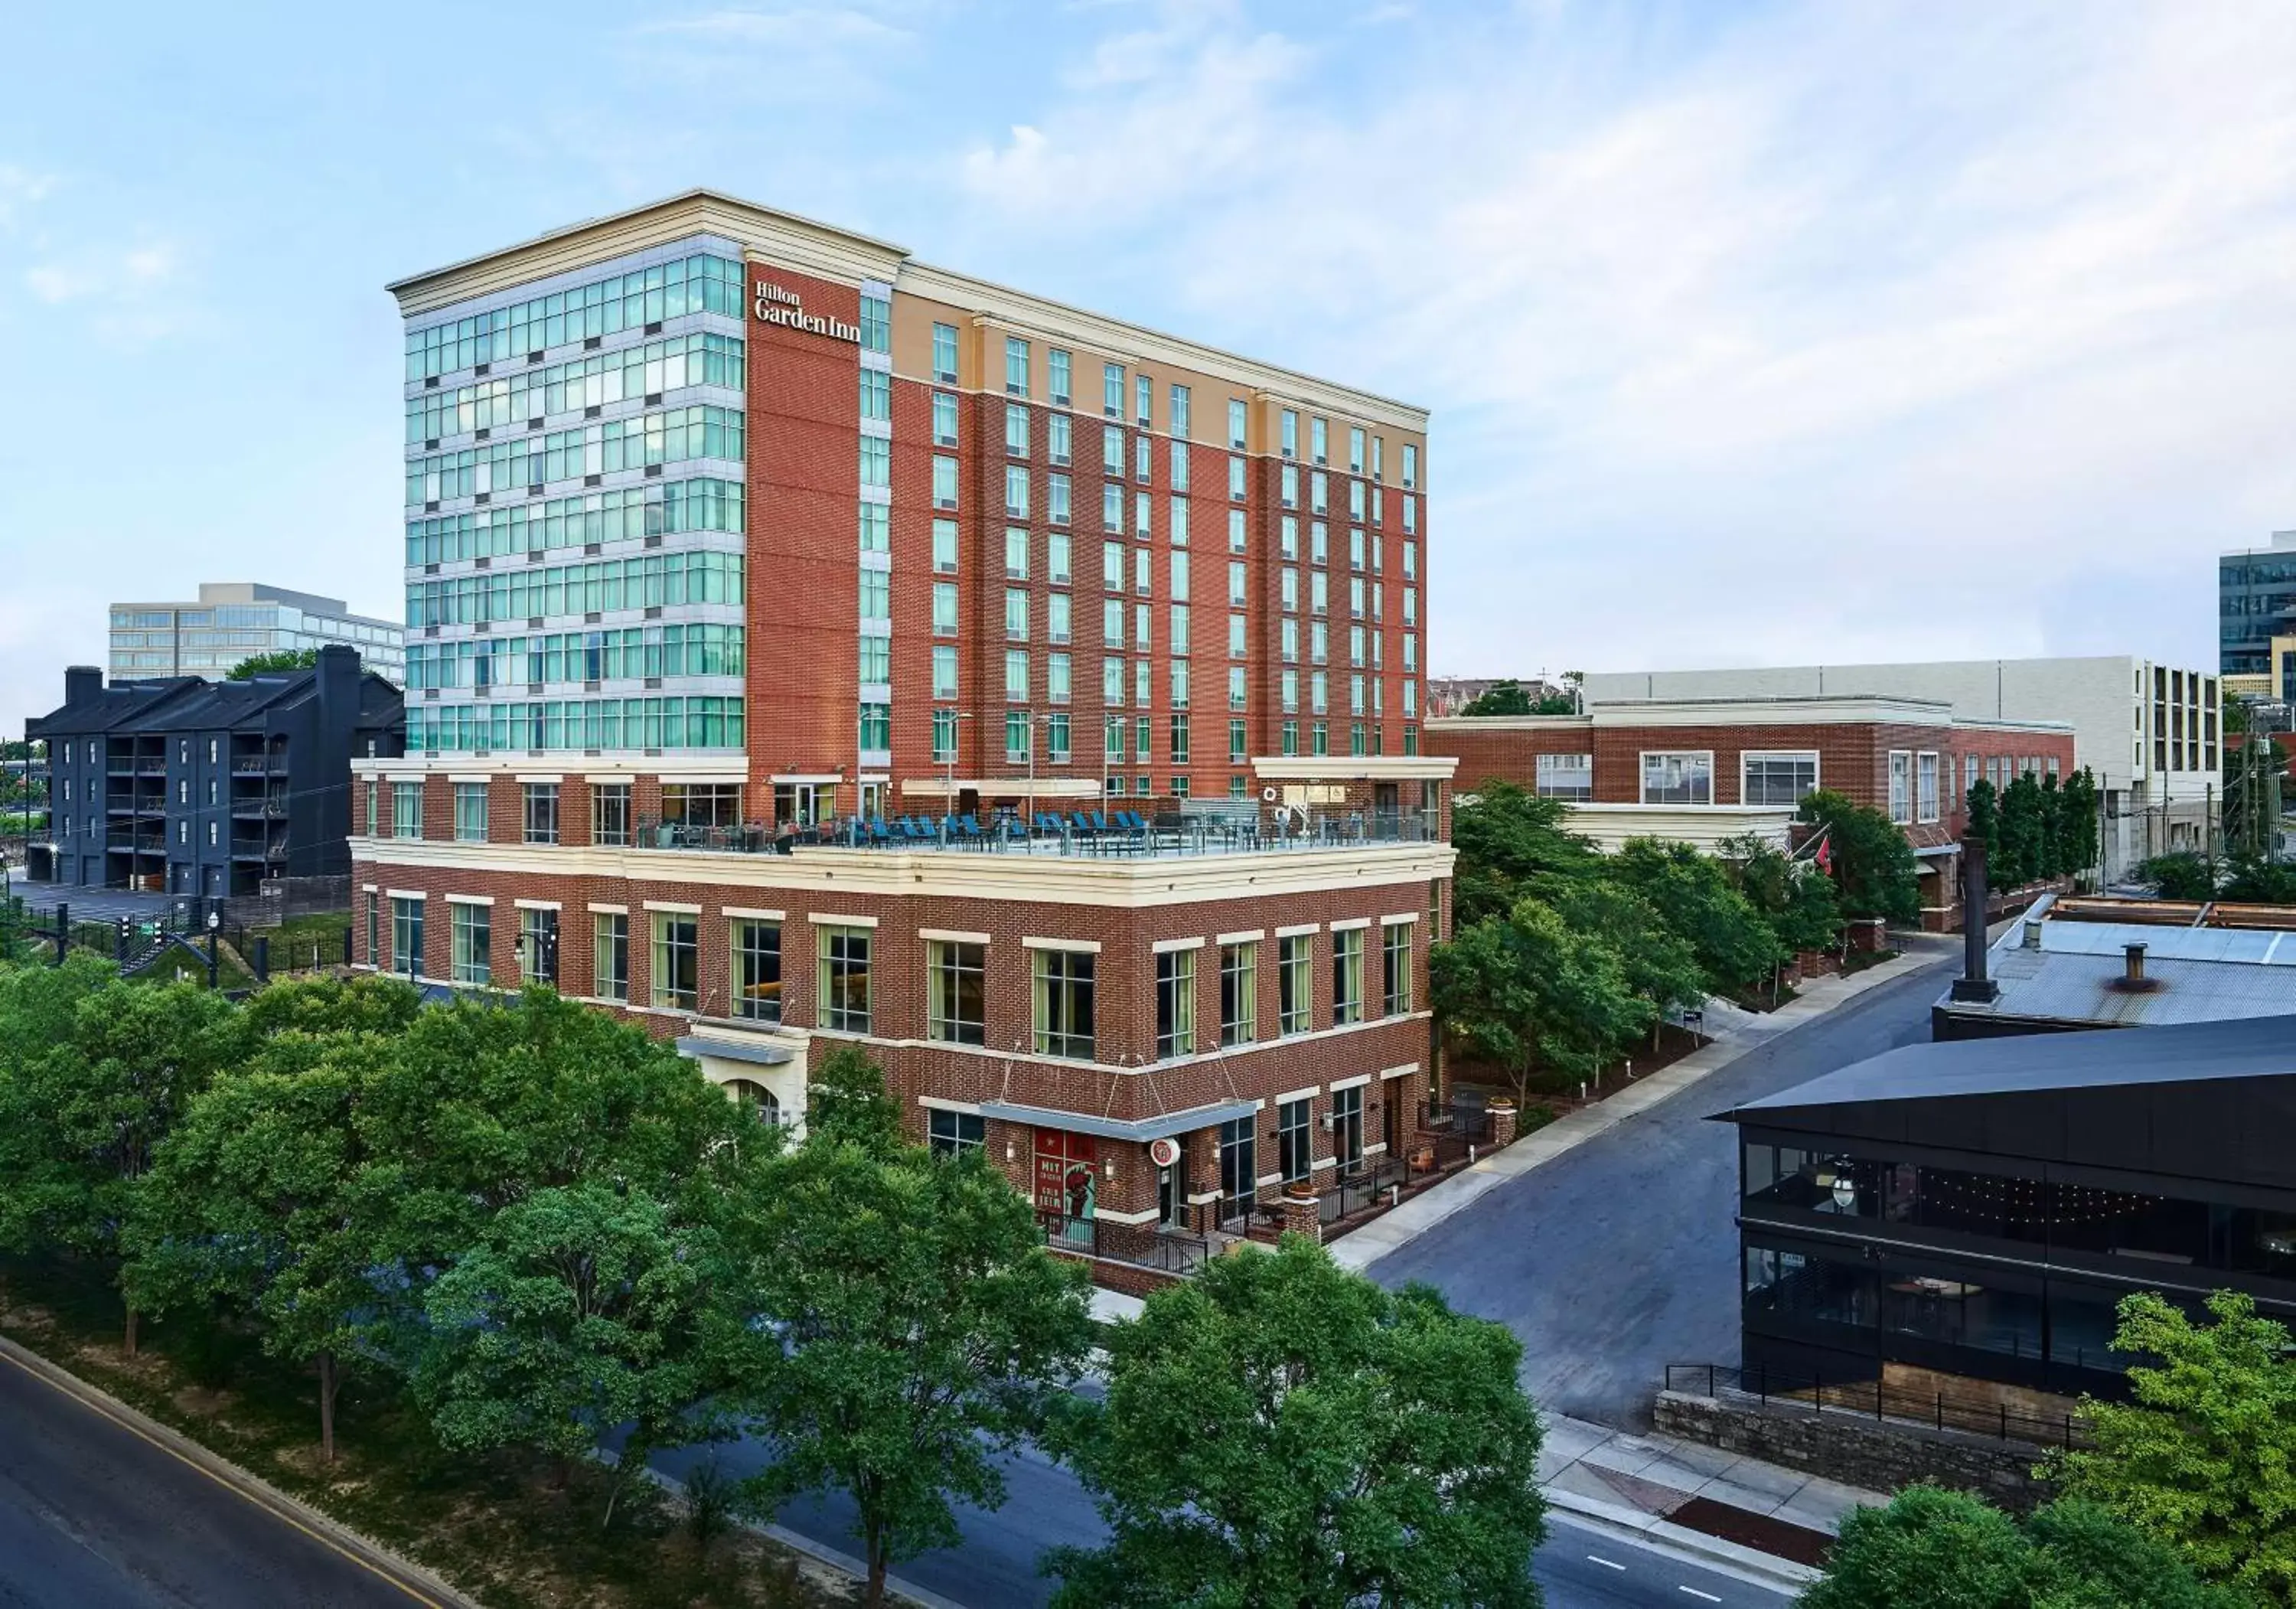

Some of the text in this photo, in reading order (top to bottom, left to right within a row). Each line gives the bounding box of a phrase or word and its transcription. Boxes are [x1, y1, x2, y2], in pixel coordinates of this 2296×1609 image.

[755, 281, 800, 305] Hilton
[755, 298, 861, 342] Garden Inn
